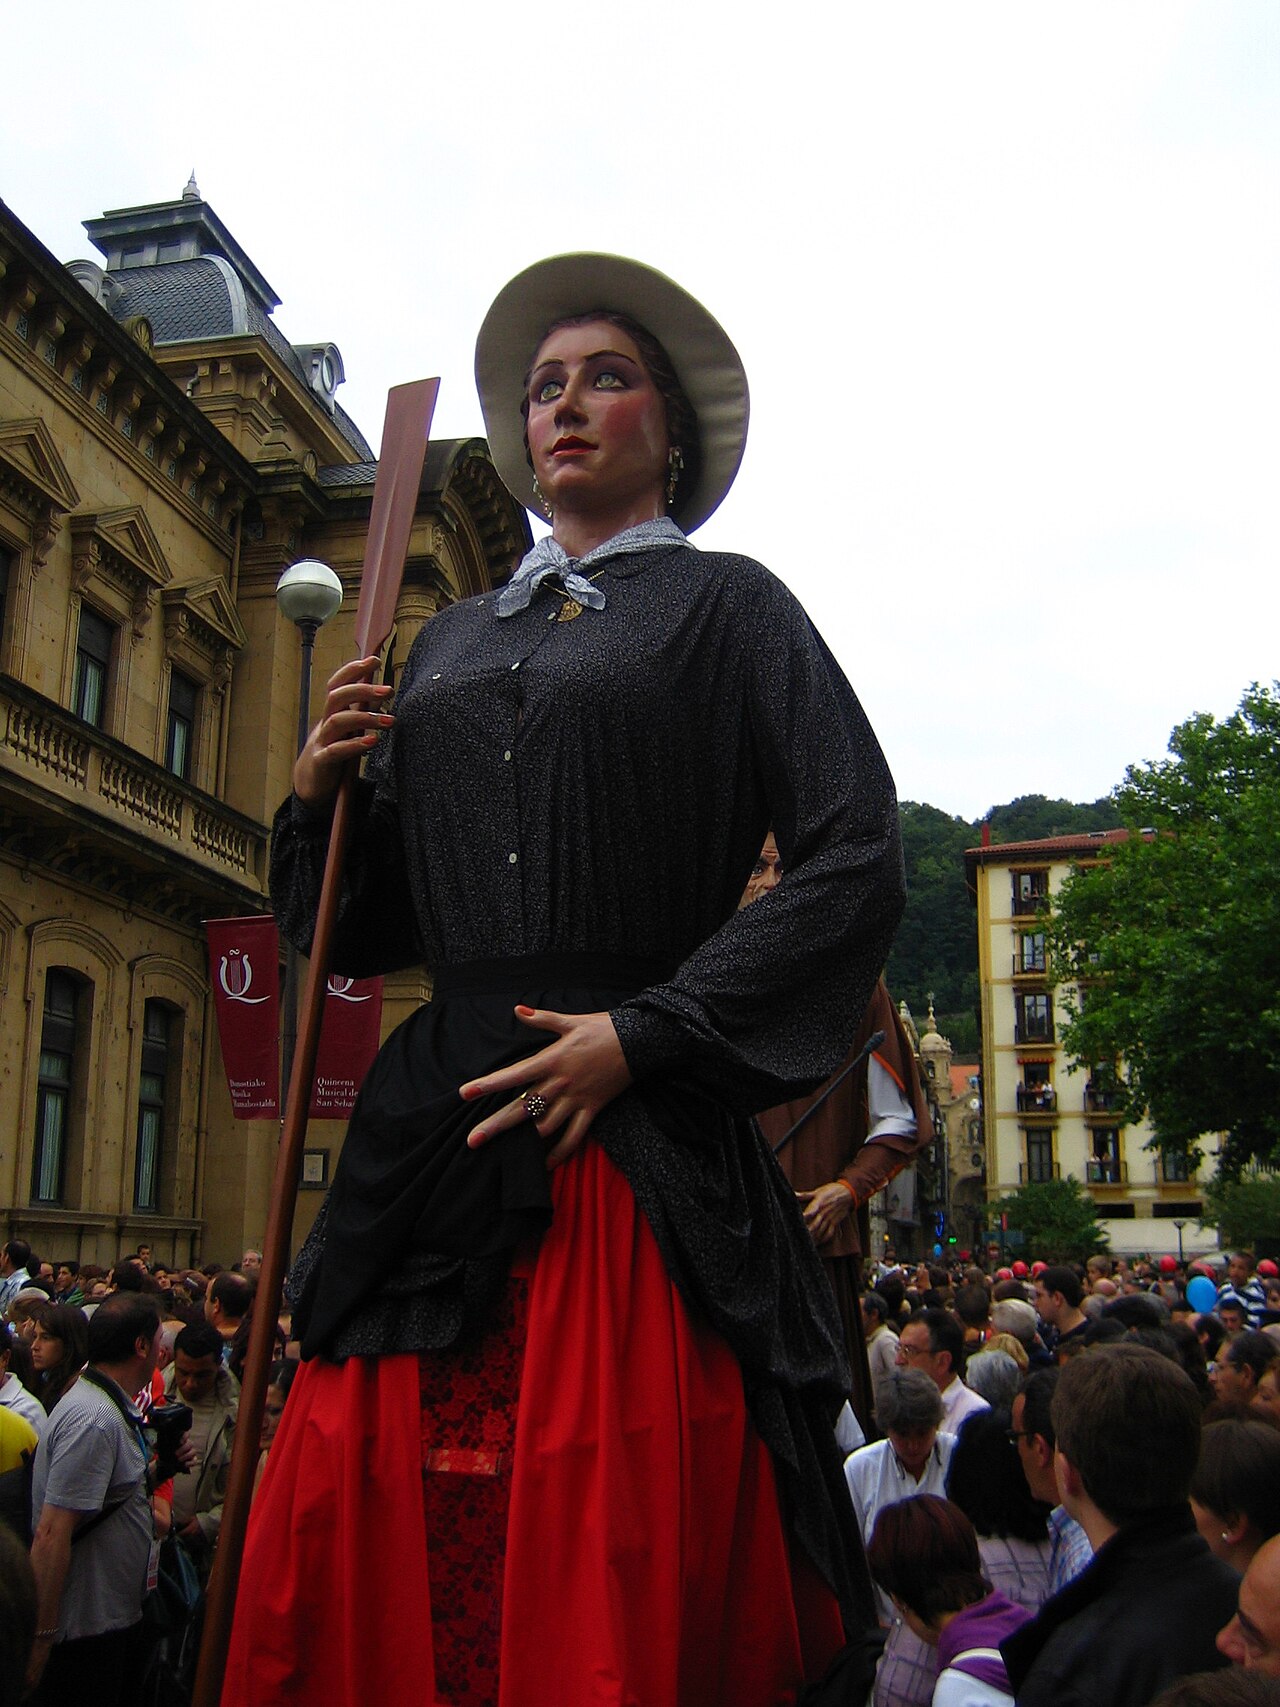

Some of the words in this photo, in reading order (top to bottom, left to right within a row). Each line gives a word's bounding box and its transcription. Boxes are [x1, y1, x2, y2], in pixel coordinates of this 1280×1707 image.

[317, 1076, 355, 1088] Quincena
[316, 1088, 347, 1097] Musical
[348, 1088, 359, 1097] de
[316, 1096, 332, 1107] San
